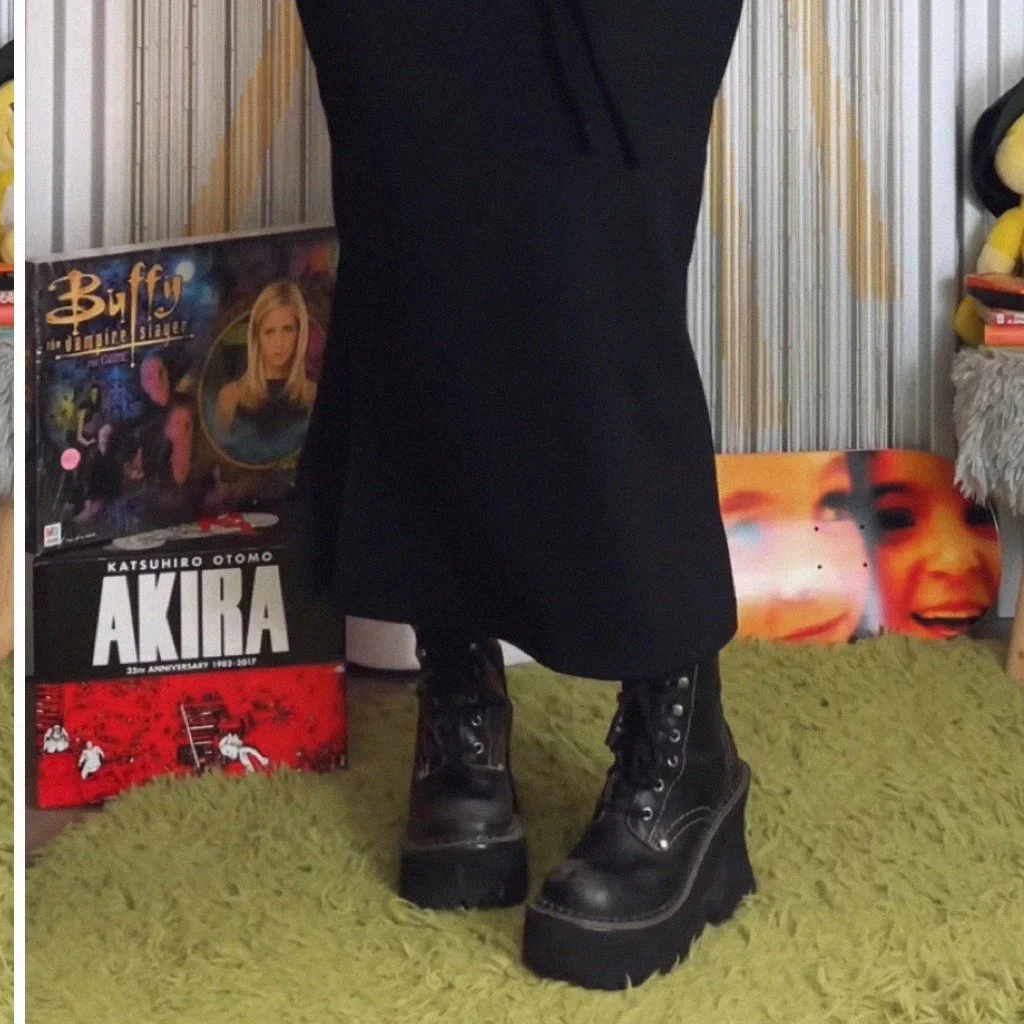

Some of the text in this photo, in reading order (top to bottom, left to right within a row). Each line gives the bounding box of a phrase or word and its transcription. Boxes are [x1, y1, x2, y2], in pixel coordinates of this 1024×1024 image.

[46, 261, 183, 368] Buffy
[107, 551, 273, 572] KATSUHIRO OTOMO
[92, 565, 290, 666] AKIRA
[147, 661, 209, 673] ANNIVERSARY
